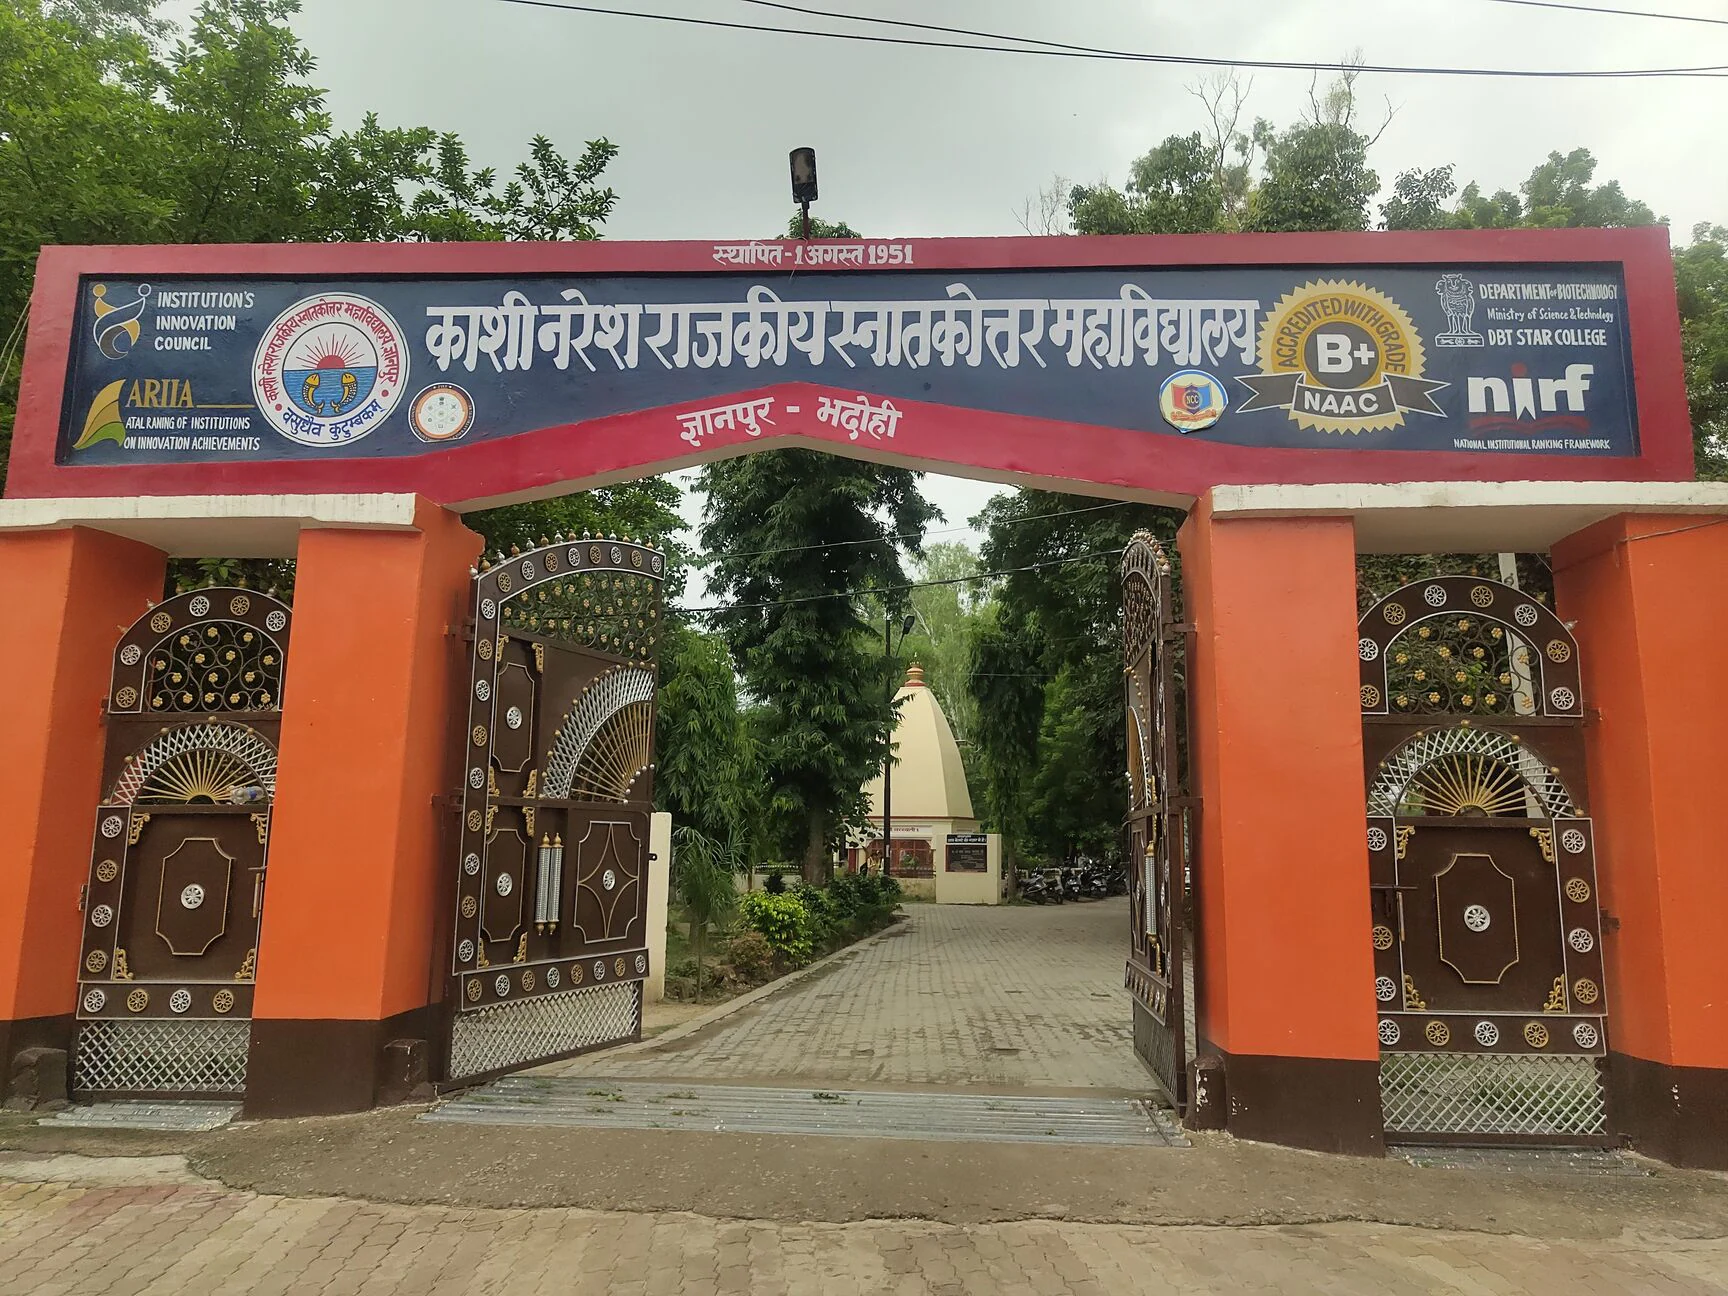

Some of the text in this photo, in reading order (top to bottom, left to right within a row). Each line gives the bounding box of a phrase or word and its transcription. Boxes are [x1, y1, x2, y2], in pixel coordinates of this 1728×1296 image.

[712, 241, 783, 266] स्थापित
[804, 245, 865, 266] अगस्त
[868, 244, 913, 264] 1951
[158, 291, 255, 308] INSTITUTION'S
[1479, 283, 1551, 300] DEPARTMENT
[1557, 284, 1617, 300] BIOTECHNOLOGY
[156, 316, 236, 330] INNOVATION
[1487, 308, 1524, 322] Ministry
[1527, 308, 1537, 320] of
[1539, 308, 1568, 321] Science
[154, 336, 212, 350] COUNCIL
[1276, 297, 1406, 372] ACCREDITED WITH GRADE
[1488, 329, 1607, 346] DBT STAR COLLEGE
[1316, 333, 1375, 373] B+
[1186, 395, 1198, 404] NCC
[1304, 390, 1379, 414] NAAC
[126, 416, 145, 429] ATAL
[176, 417, 187, 429] OF
[191, 417, 250, 430] INSTITUTIONS
[676, 397, 776, 447] ज्ञानपुर
[816, 396, 902, 440] भदोही
[124, 437, 260, 450] ON INNOVATION ACHIEVEMENTS
[1454, 438, 1610, 450] NATIONAL INSTITUTIONAL RANKING FRAMEWORK
